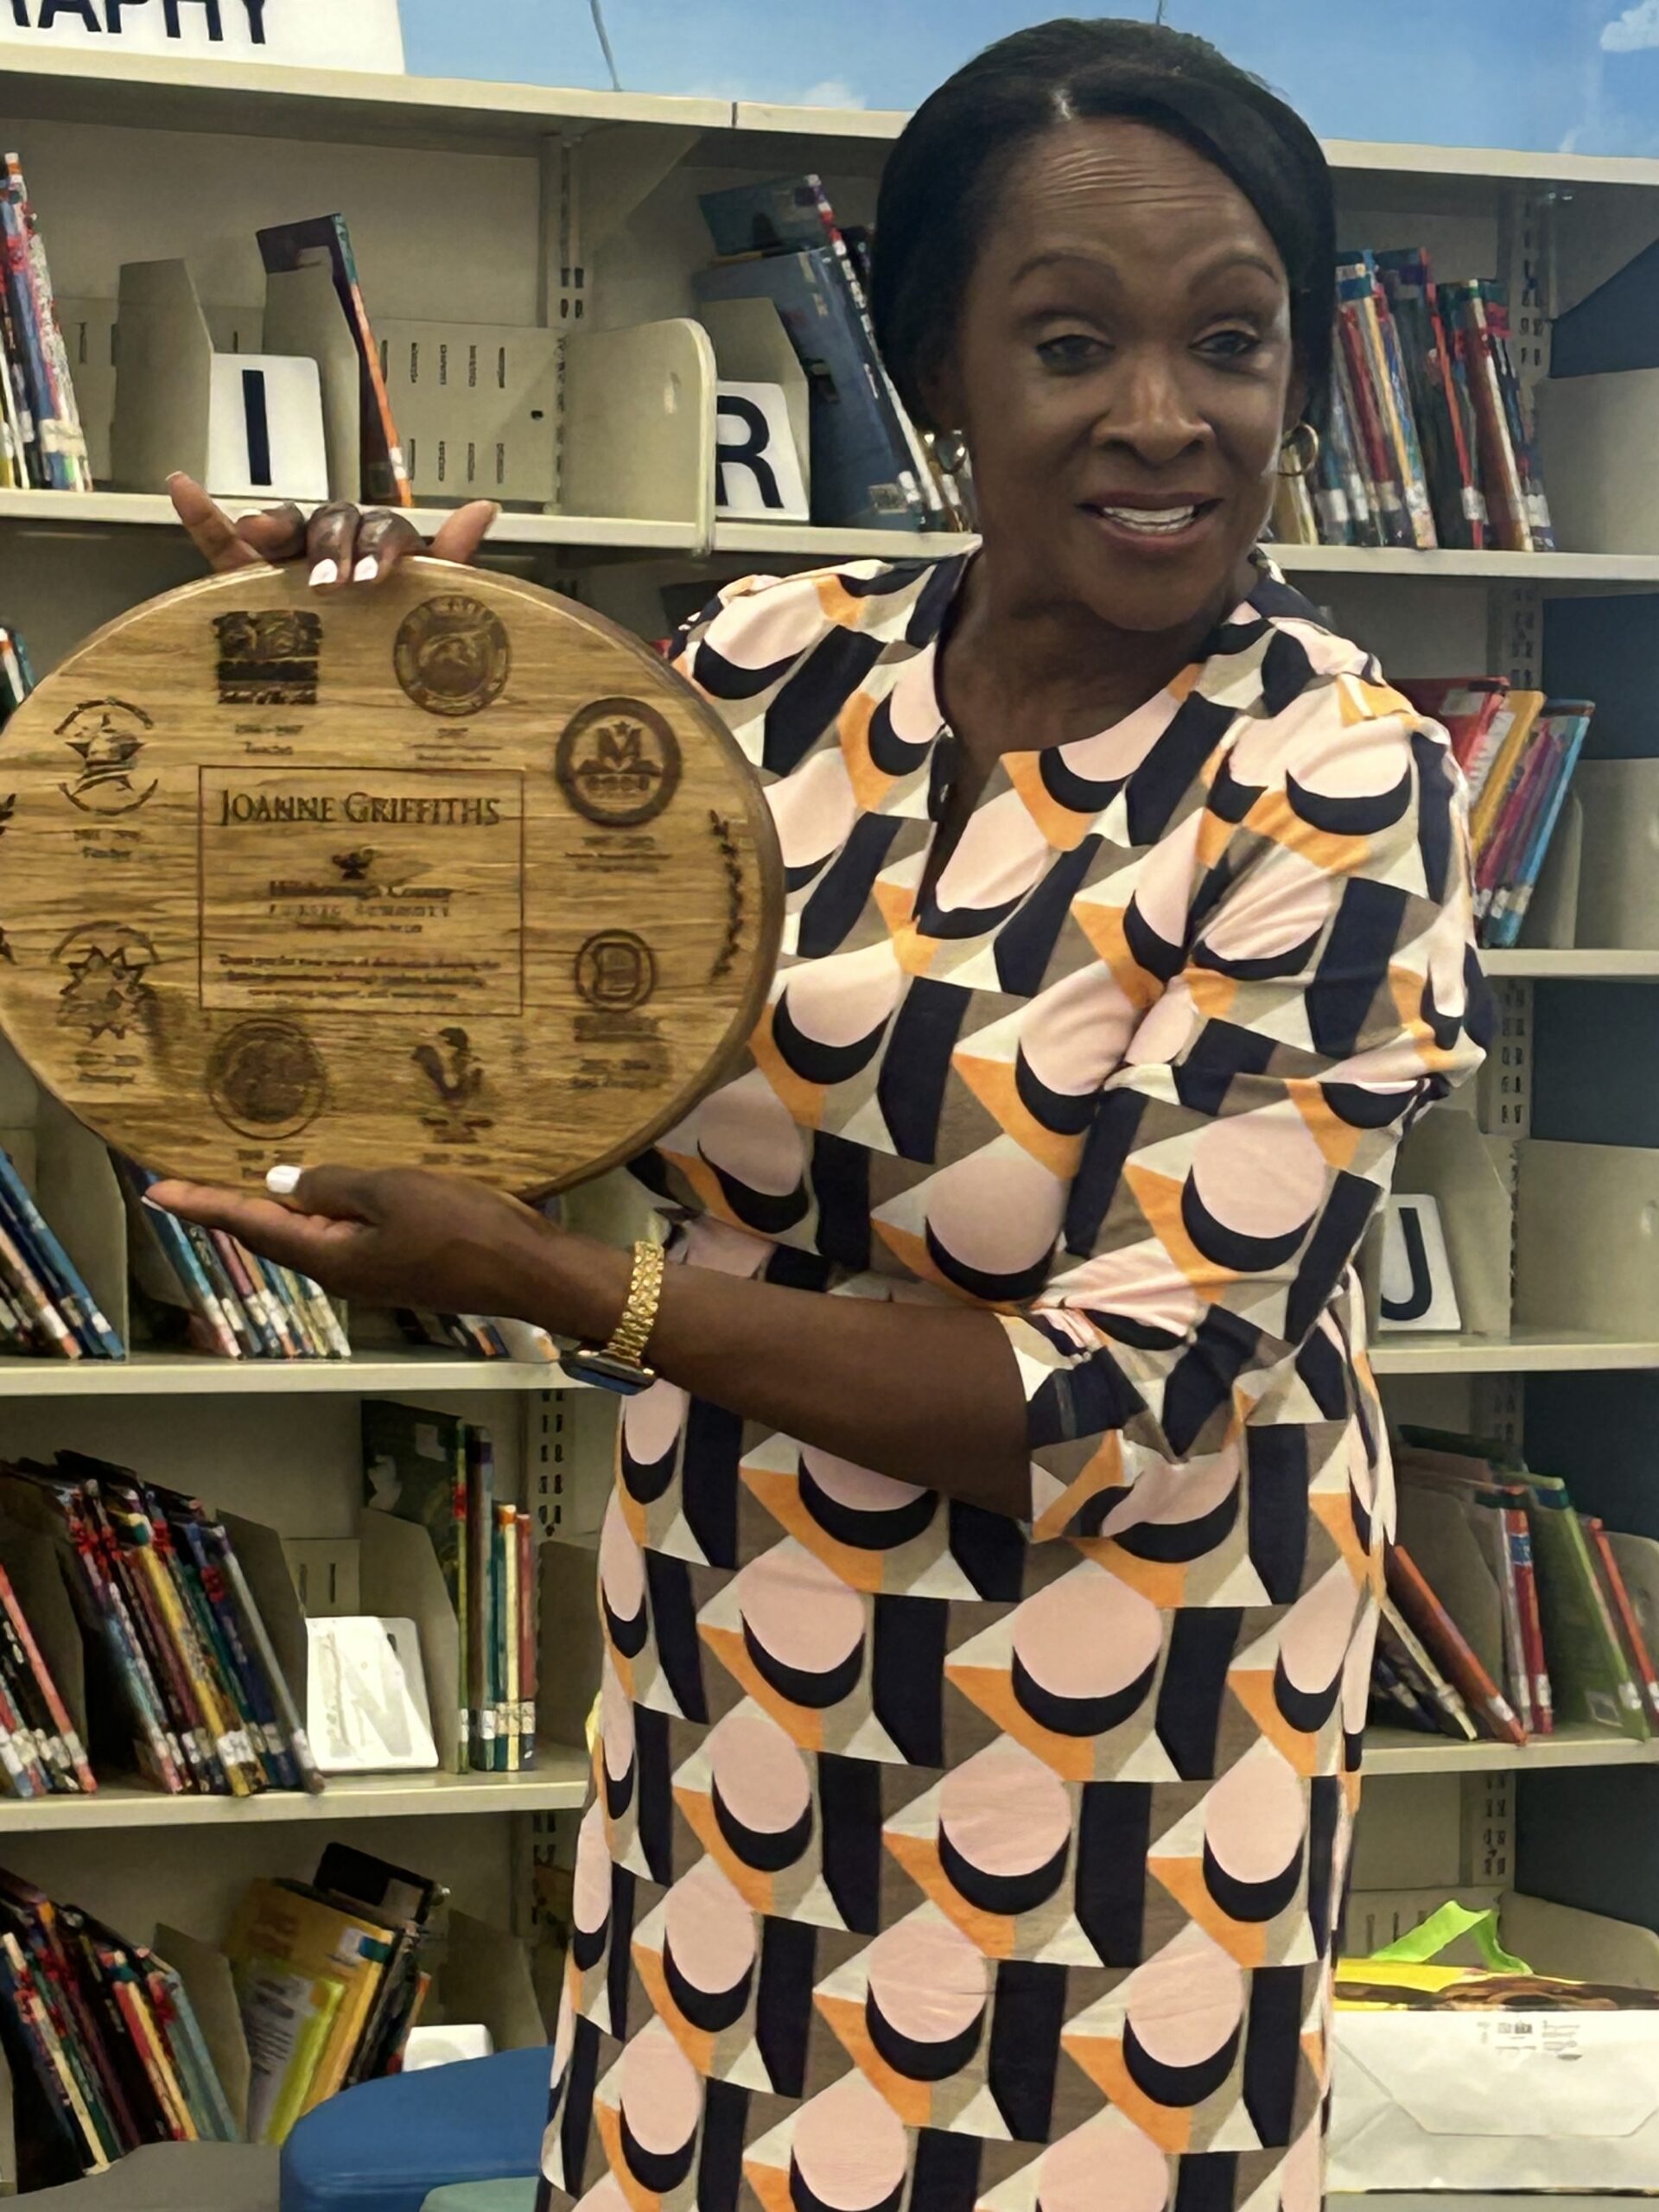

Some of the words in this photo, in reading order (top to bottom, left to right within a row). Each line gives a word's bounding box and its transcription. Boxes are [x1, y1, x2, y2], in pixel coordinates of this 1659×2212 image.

[242, 369, 272, 486] I
[715, 395, 785, 508] R
[222, 789, 337, 826] JOANNE
[346, 791, 500, 825] GRIFFITHS
